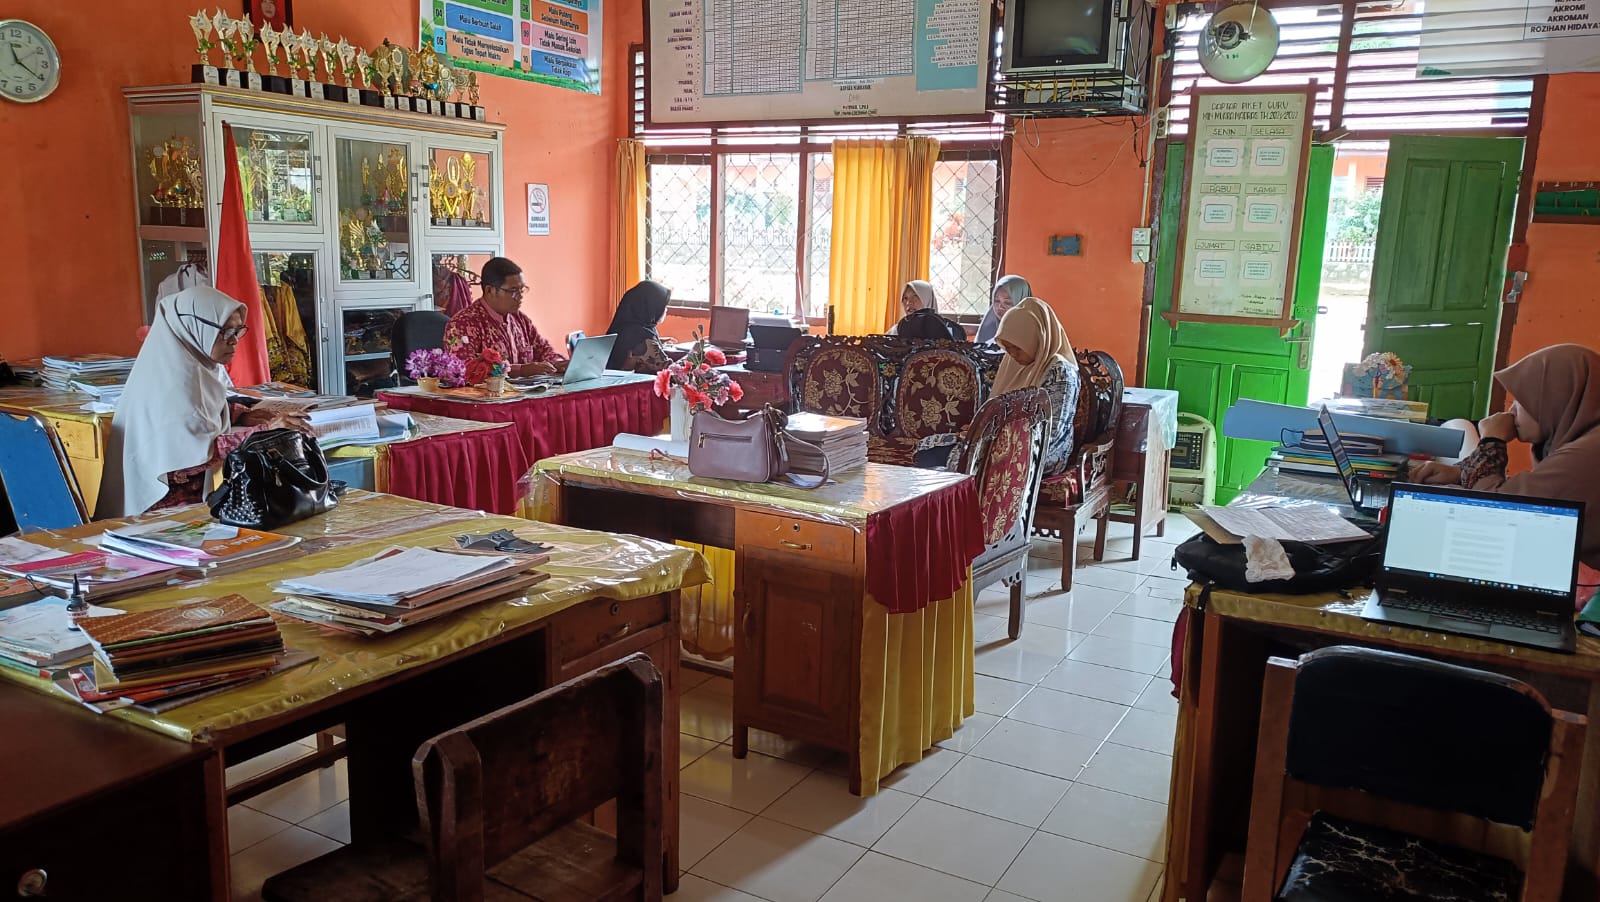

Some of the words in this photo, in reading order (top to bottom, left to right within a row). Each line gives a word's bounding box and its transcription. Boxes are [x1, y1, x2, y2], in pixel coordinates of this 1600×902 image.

[435, 8, 443, 17] 04
[1553, 4, 1586, 12] AKROMI
[459, 13, 471, 24] Malu
[1547, 13, 1589, 22] AKROMAN
[1530, 24, 1567, 33] ROZIHAN
[10, 29, 22, 38] 12
[544, 30, 555, 40] Malu
[28, 36, 32, 44] 1
[436, 36, 444, 46] 05
[452, 34, 463, 44] Malu
[464, 37, 477, 47] Tidak
[36, 46, 44, 55] 2
[41, 60, 49, 69] 3
[1, 79, 9, 88] 7
[28, 83, 37, 91] 5
[15, 85, 23, 94] 6
[1267, 100, 1289, 110] GURU
[1212, 128, 1237, 136] SENIN
[1209, 185, 1233, 193] RABU
